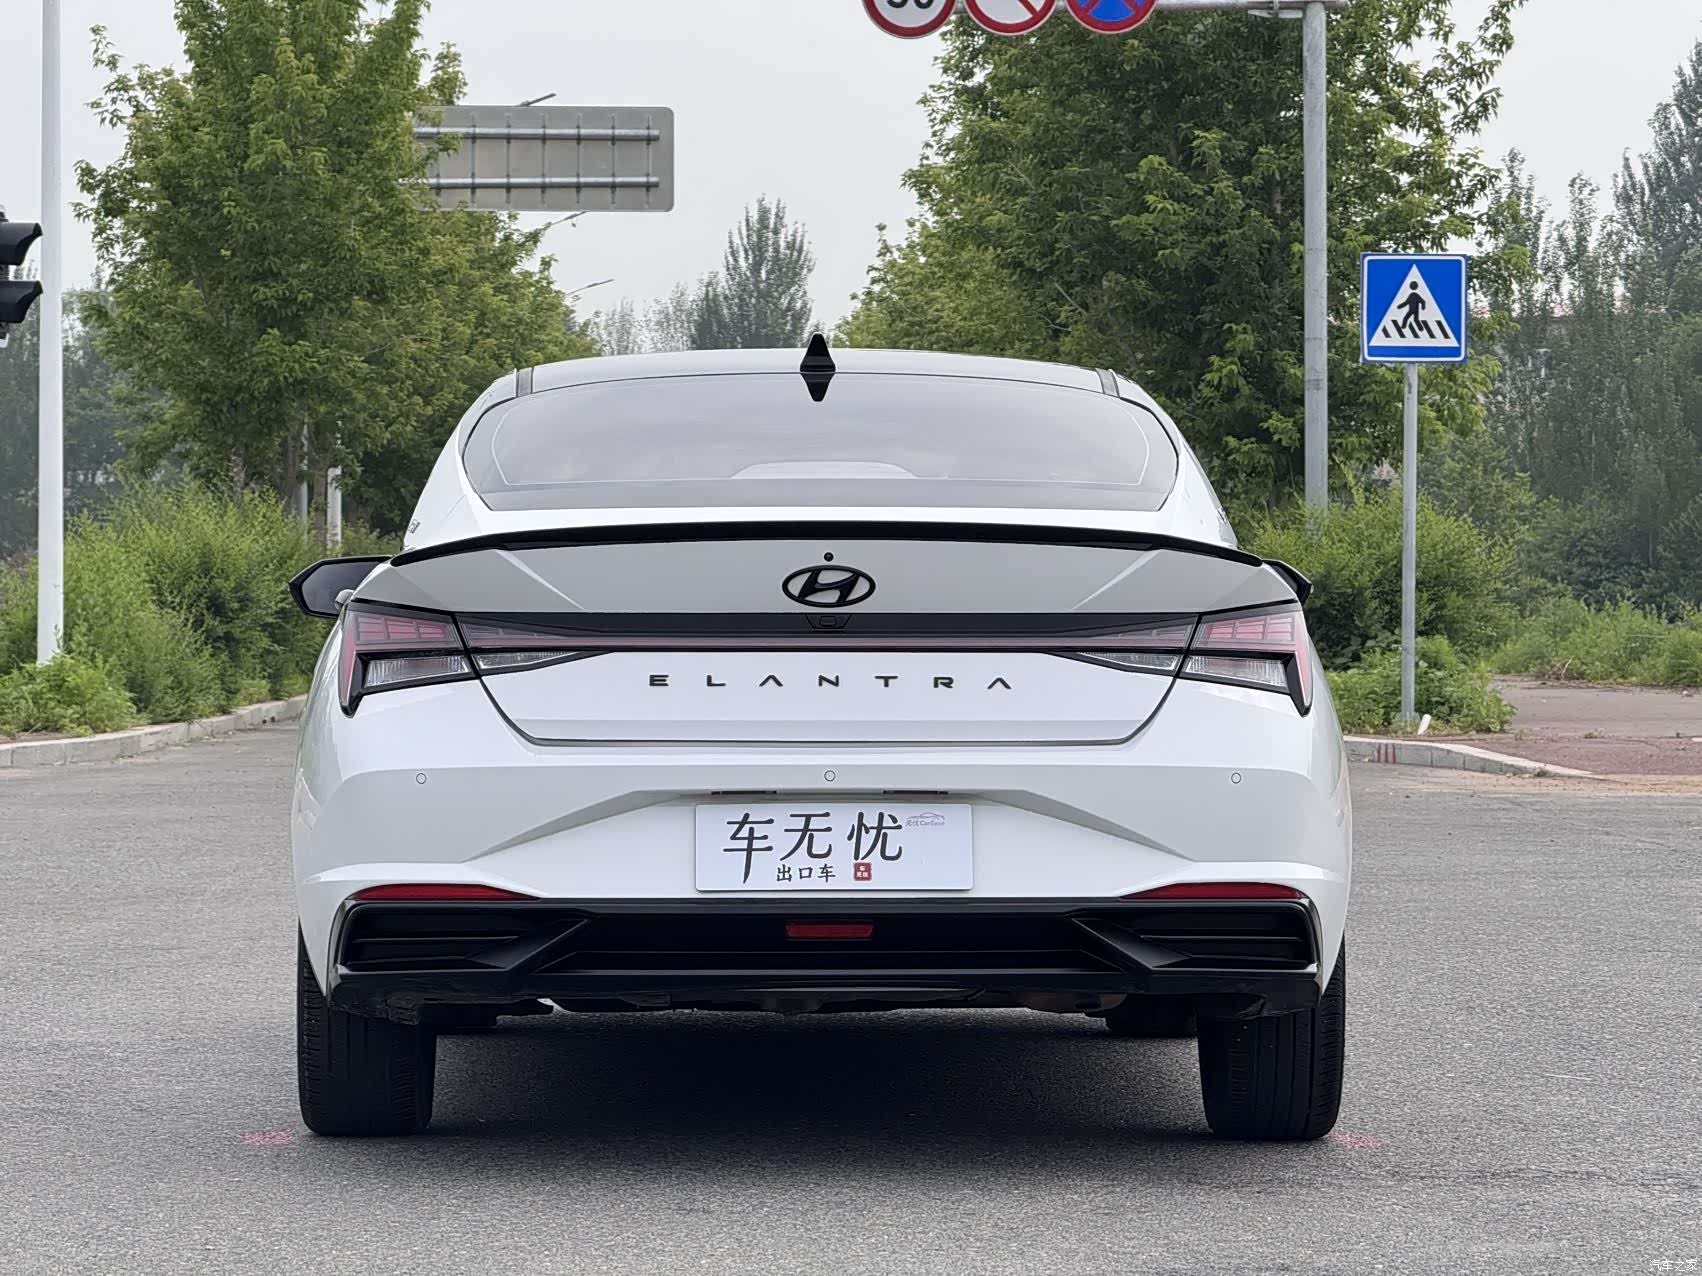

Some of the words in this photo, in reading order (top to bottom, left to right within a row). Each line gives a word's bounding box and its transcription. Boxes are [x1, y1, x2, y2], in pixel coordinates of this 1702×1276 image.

[649, 674, 1012, 690] ELANTRA
[723, 811, 903, 884] 车无忧
[776, 863, 836, 883] 出口车
